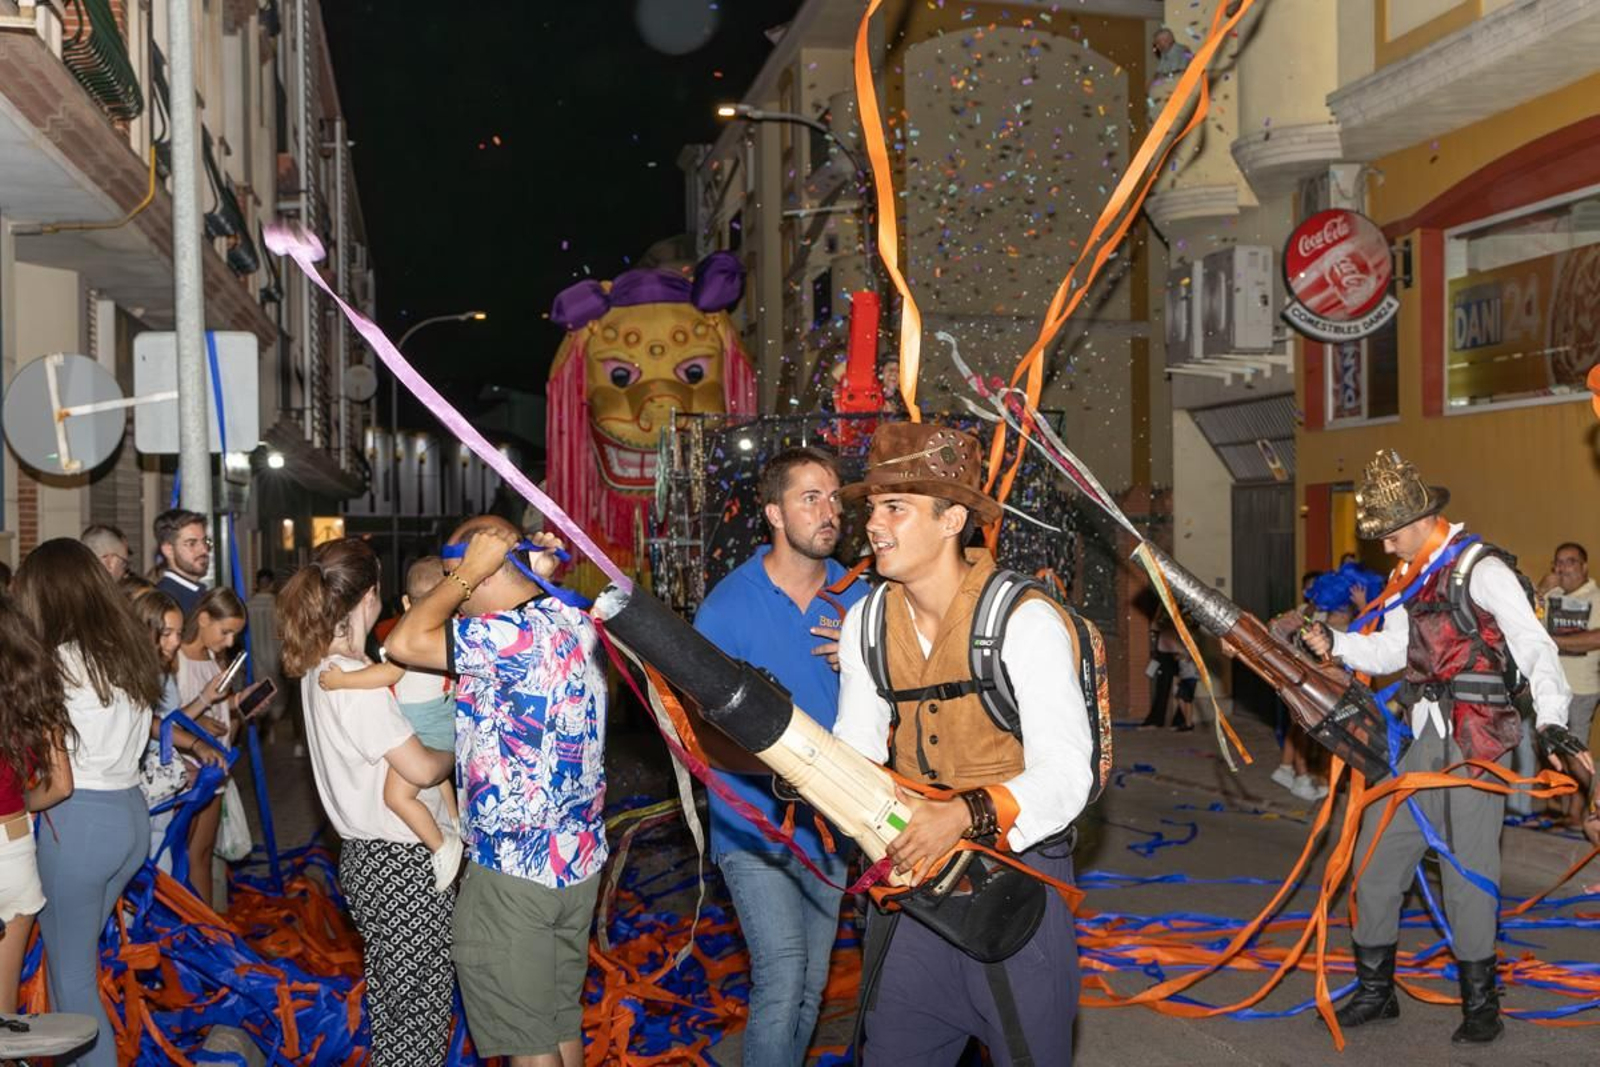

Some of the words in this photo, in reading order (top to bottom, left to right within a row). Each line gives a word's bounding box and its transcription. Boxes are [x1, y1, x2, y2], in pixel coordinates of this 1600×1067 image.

[1291, 306, 1361, 335] COMESTIBLES
[1362, 301, 1394, 330] DANI24
[1455, 297, 1502, 349] DANI
[1503, 273, 1541, 343] 24
